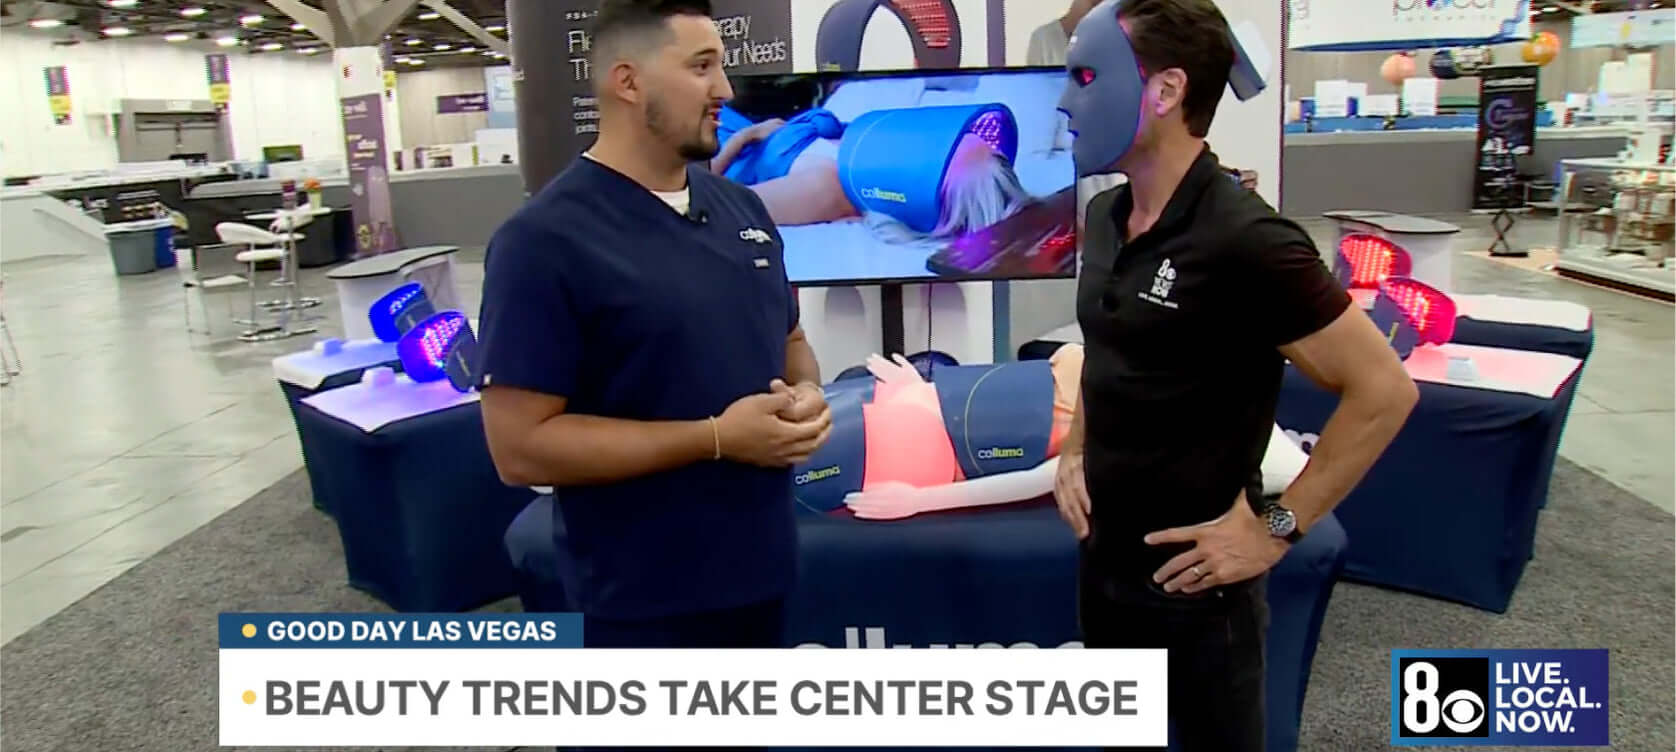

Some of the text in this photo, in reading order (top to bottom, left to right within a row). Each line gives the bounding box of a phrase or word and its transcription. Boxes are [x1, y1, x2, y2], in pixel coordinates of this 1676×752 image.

[743, 36, 786, 65] Needs
[977, 447, 1024, 459] colluma
[795, 466, 840, 485] colluma
